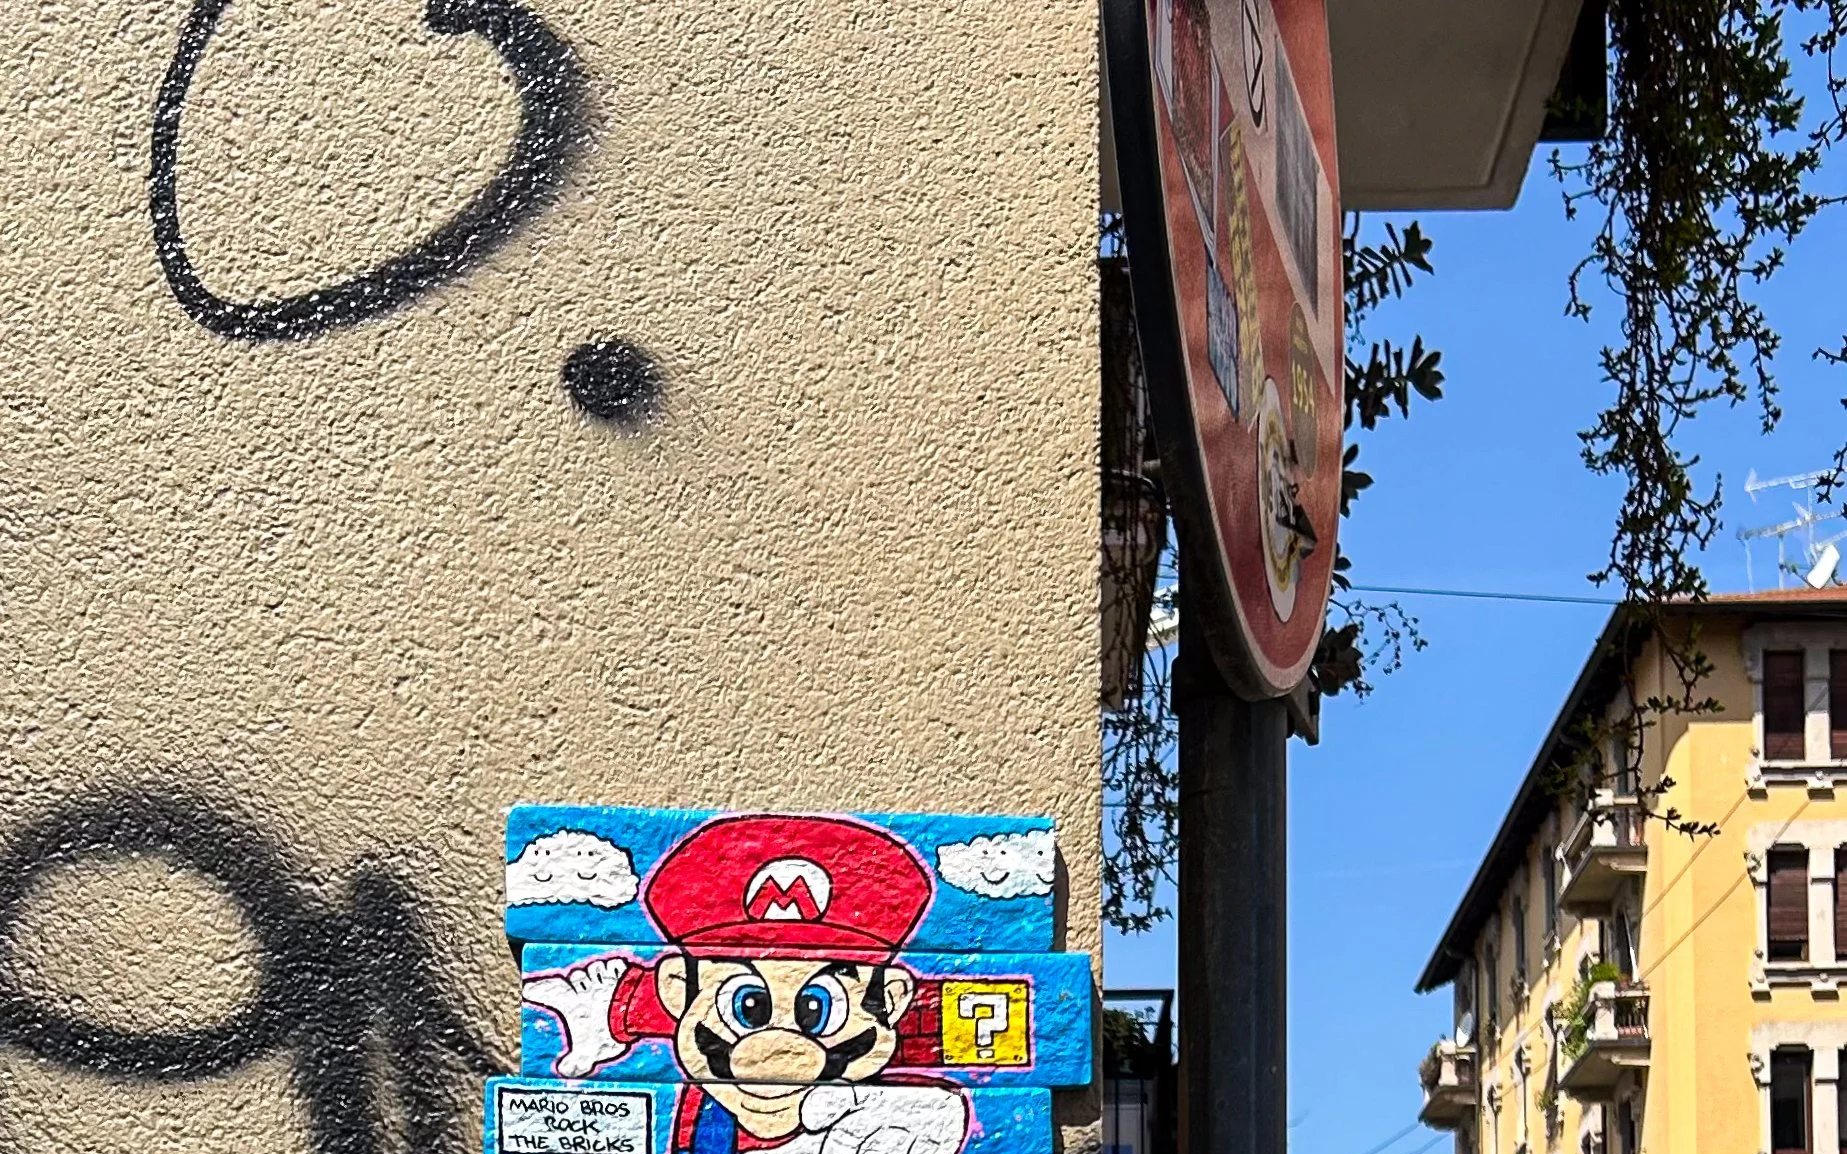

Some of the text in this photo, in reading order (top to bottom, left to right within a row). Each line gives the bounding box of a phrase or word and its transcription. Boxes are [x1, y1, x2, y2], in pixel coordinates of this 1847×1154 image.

[509, 1097, 631, 1118] MARIO BROS
[544, 1116, 601, 1135] ROCK
[508, 1134, 635, 1153] THE BRICKS
